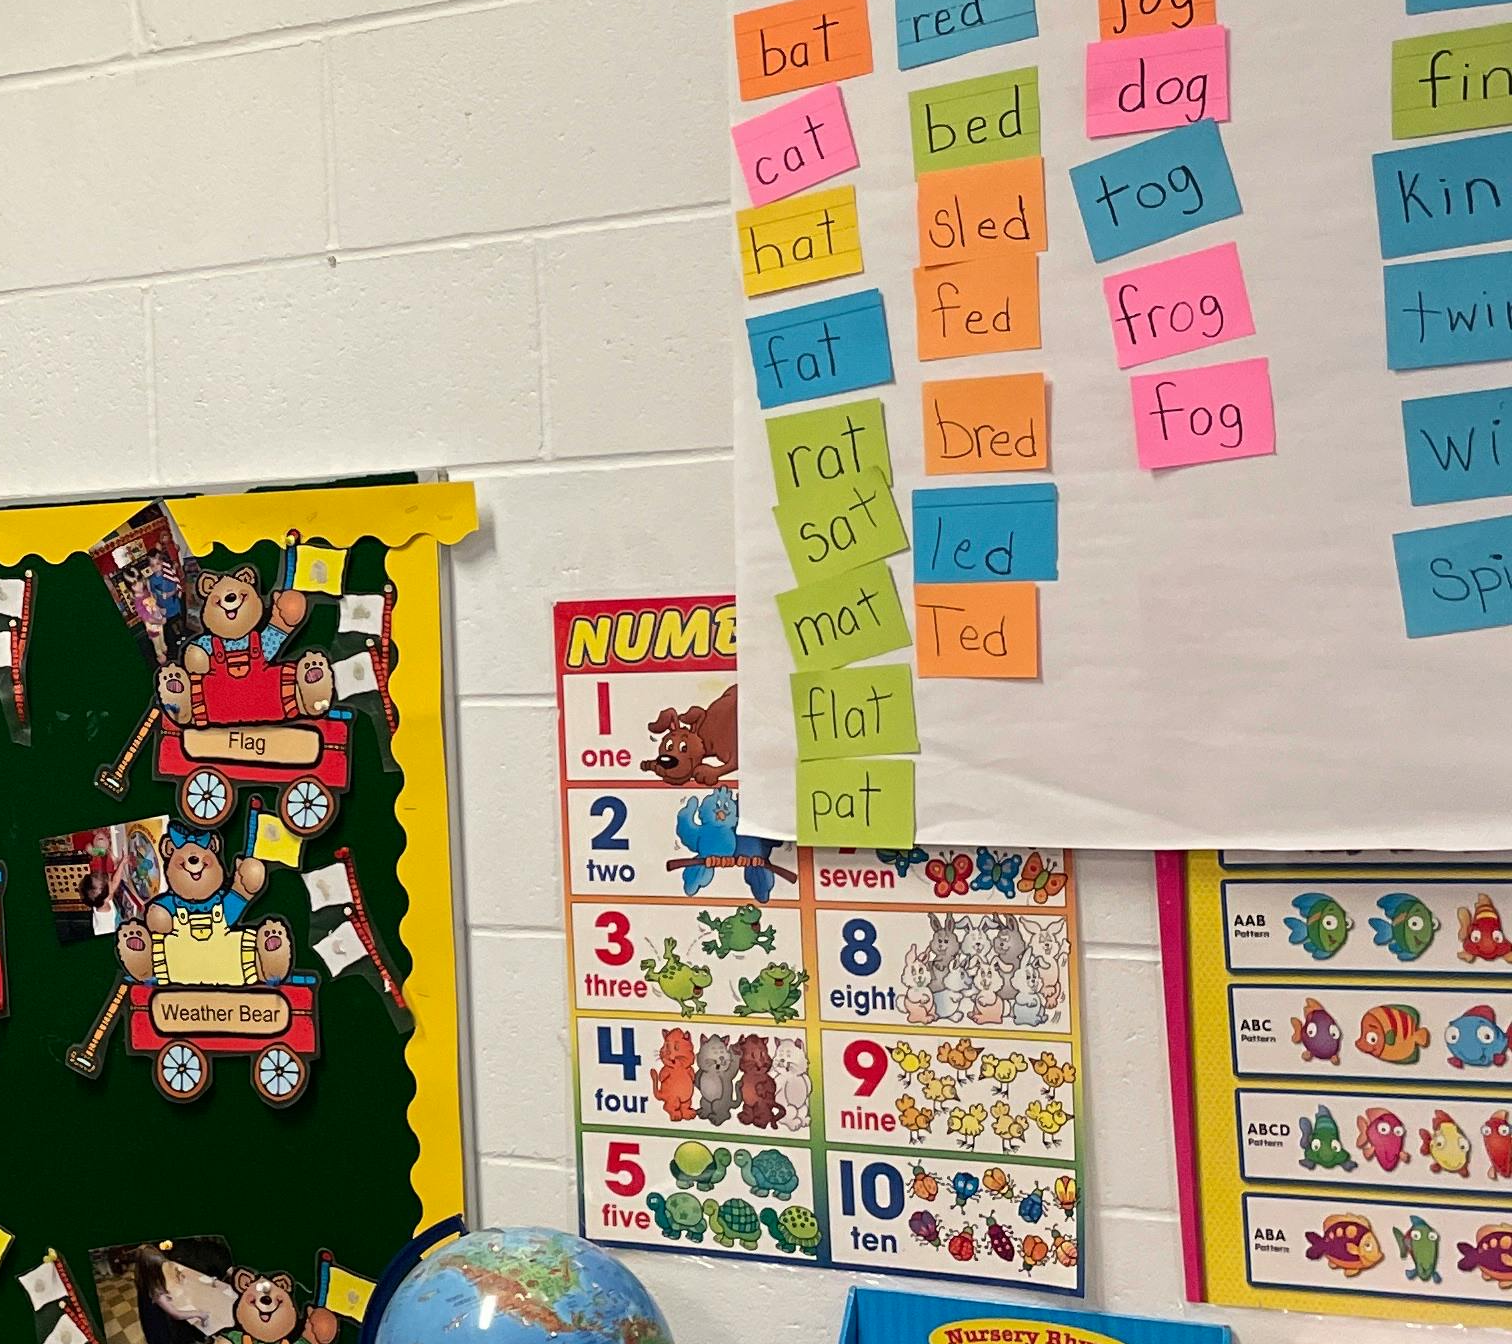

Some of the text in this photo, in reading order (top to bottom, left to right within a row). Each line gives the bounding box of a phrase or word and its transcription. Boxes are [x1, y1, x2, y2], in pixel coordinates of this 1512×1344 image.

[760, 13, 839, 76] bat
[1118, 57, 1208, 123] dog
[1418, 48, 1512, 109] fin
[925, 83, 1022, 154] bed
[755, 115, 825, 185] cat
[1096, 164, 1204, 227] tog
[749, 208, 835, 274] hat
[932, 282, 1011, 338] fed
[1115, 283, 1224, 345] frog
[1402, 290, 1512, 344] twi
[764, 322, 840, 389] fat
[934, 398, 1037, 459] bred
[1149, 381, 1243, 449] fog
[787, 415, 866, 488] rat
[799, 487, 877, 563] sat
[931, 516, 1014, 575] led
[794, 587, 879, 656] mat
[916, 603, 1008, 657] Ted
[597, 681, 612, 735] 1
[801, 686, 894, 741] flat
[228, 731, 266, 755] Flag
[581, 748, 631, 768] one
[590, 796, 630, 850] 2
[812, 771, 882, 832] pat
[587, 859, 636, 882] two
[819, 867, 895, 890] seven
[594, 911, 634, 966] 3
[840, 917, 882, 977] 8
[1234, 914, 1266, 927] AAB
[1234, 929, 1270, 939] Pattern
[161, 1004, 280, 1023] Weather Bear
[585, 974, 648, 998] three
[830, 986, 897, 1016] eight
[1240, 1019, 1272, 1032] ABC
[1241, 1034, 1276, 1044] Pattern
[597, 1026, 641, 1081] 4
[843, 1039, 888, 1097] 9
[594, 1088, 648, 1114] four
[840, 1107, 896, 1132] nine
[1247, 1123, 1291, 1136] ABCD
[1248, 1138, 1284, 1148] Pattern
[605, 1141, 645, 1197] 5
[839, 1159, 905, 1220] 10
[601, 1204, 651, 1230] five
[850, 1225, 898, 1254] ten
[1254, 1227, 1287, 1242] ABA
[1254, 1243, 1290, 1254] Pattern
